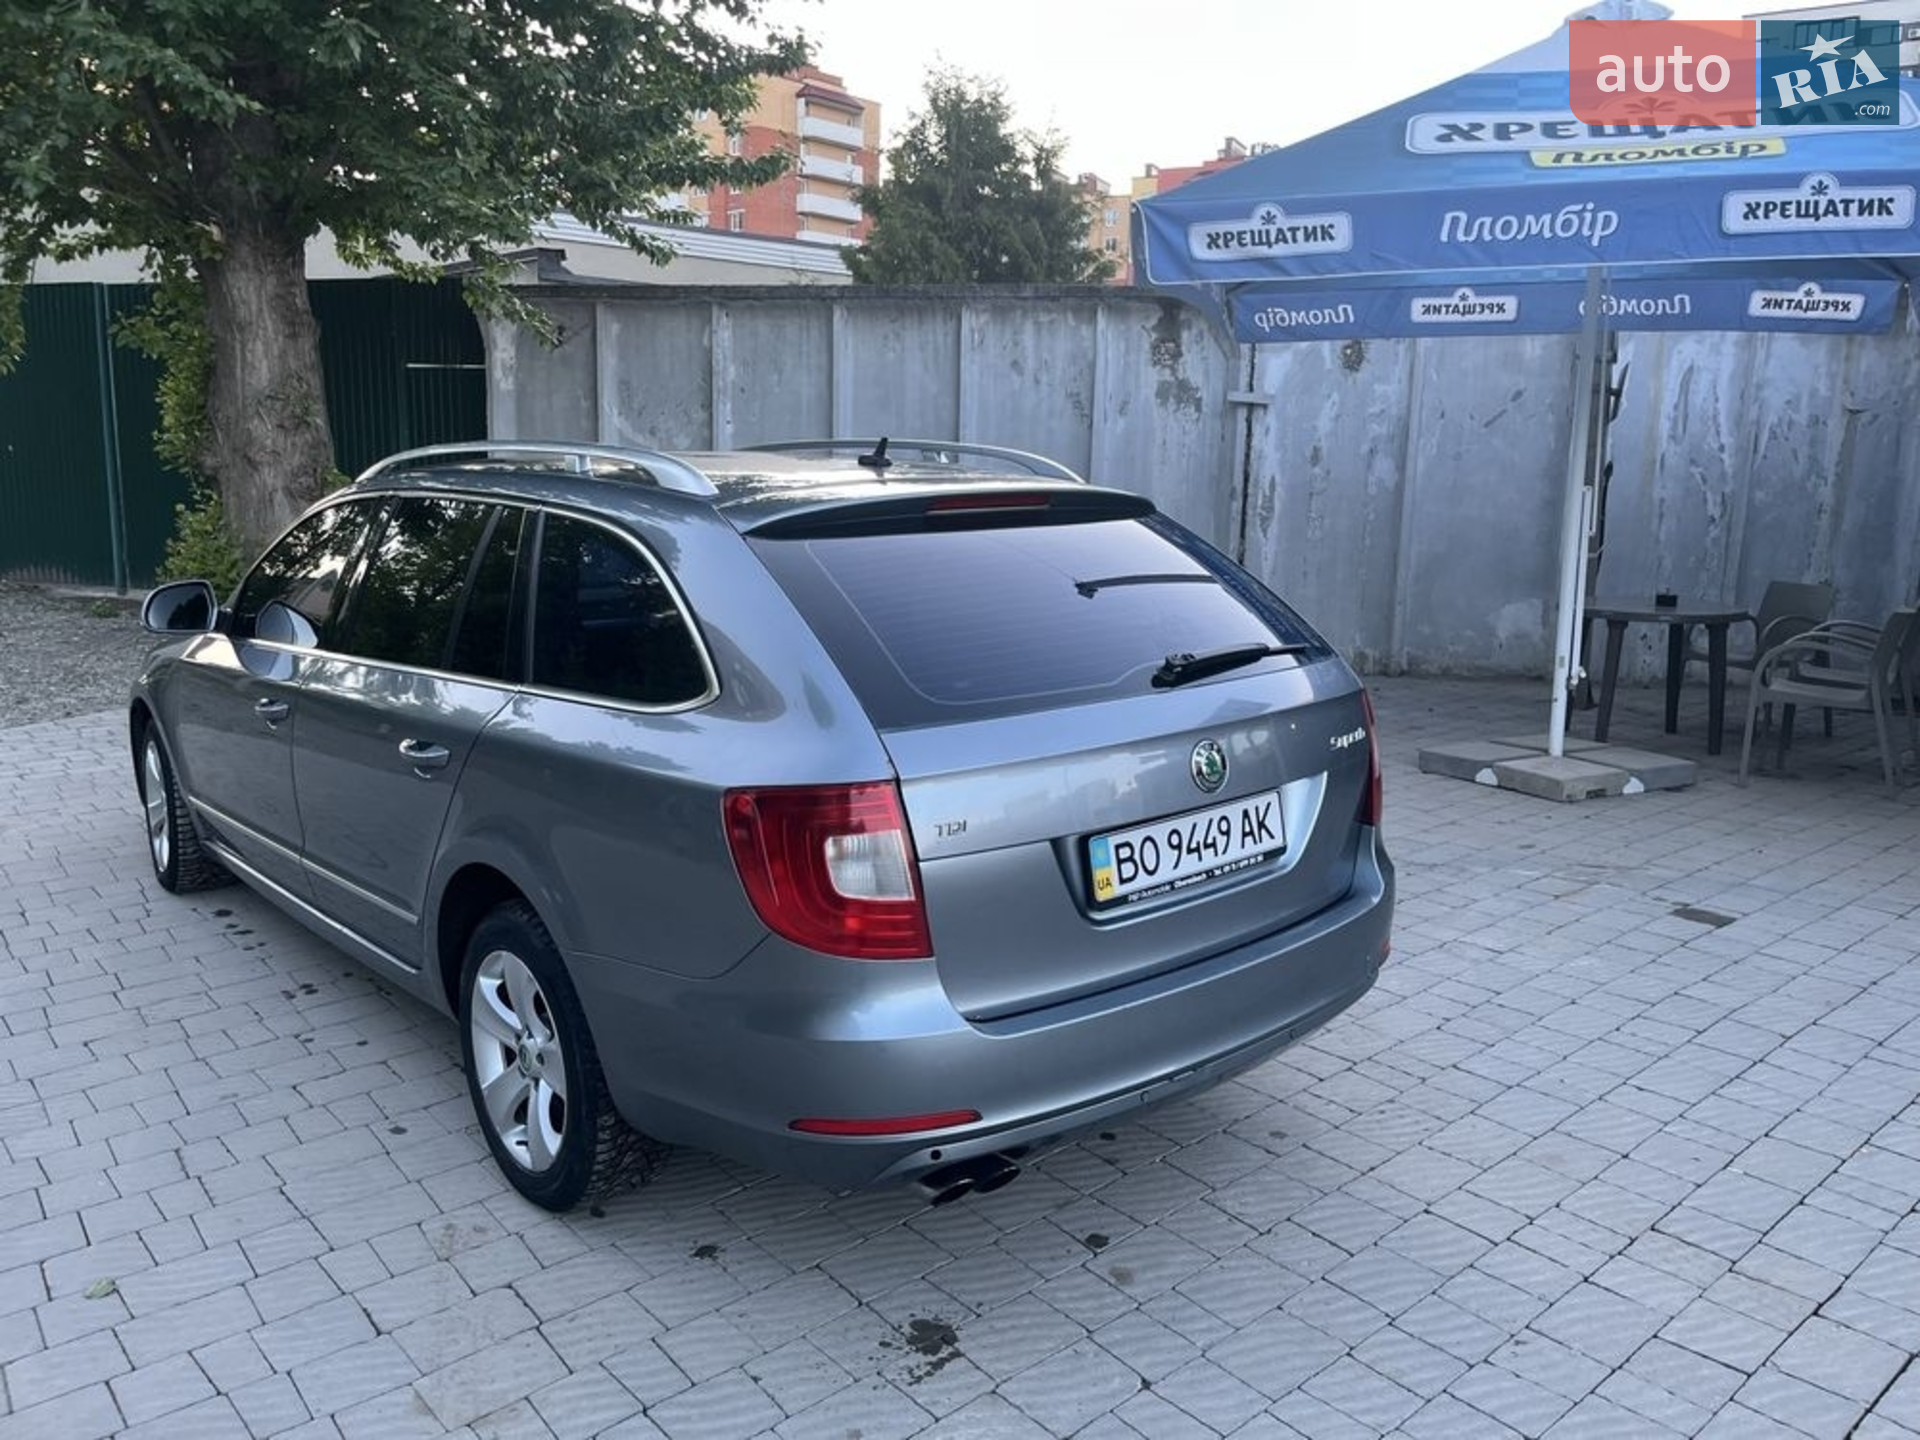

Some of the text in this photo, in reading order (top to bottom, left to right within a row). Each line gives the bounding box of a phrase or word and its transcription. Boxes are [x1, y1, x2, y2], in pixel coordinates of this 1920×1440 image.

[1551, 140, 1768, 165] Пломбір
[1743, 197, 1895, 222] ХРЕЩАТИК
[1206, 223, 1335, 249] ХРЕЩАТИК
[1439, 201, 1620, 247] Пломбір
[1114, 835, 1160, 885] BO
[1167, 815, 1231, 870] 9449
[1241, 802, 1275, 849] AK
[1097, 877, 1113, 891] UA
